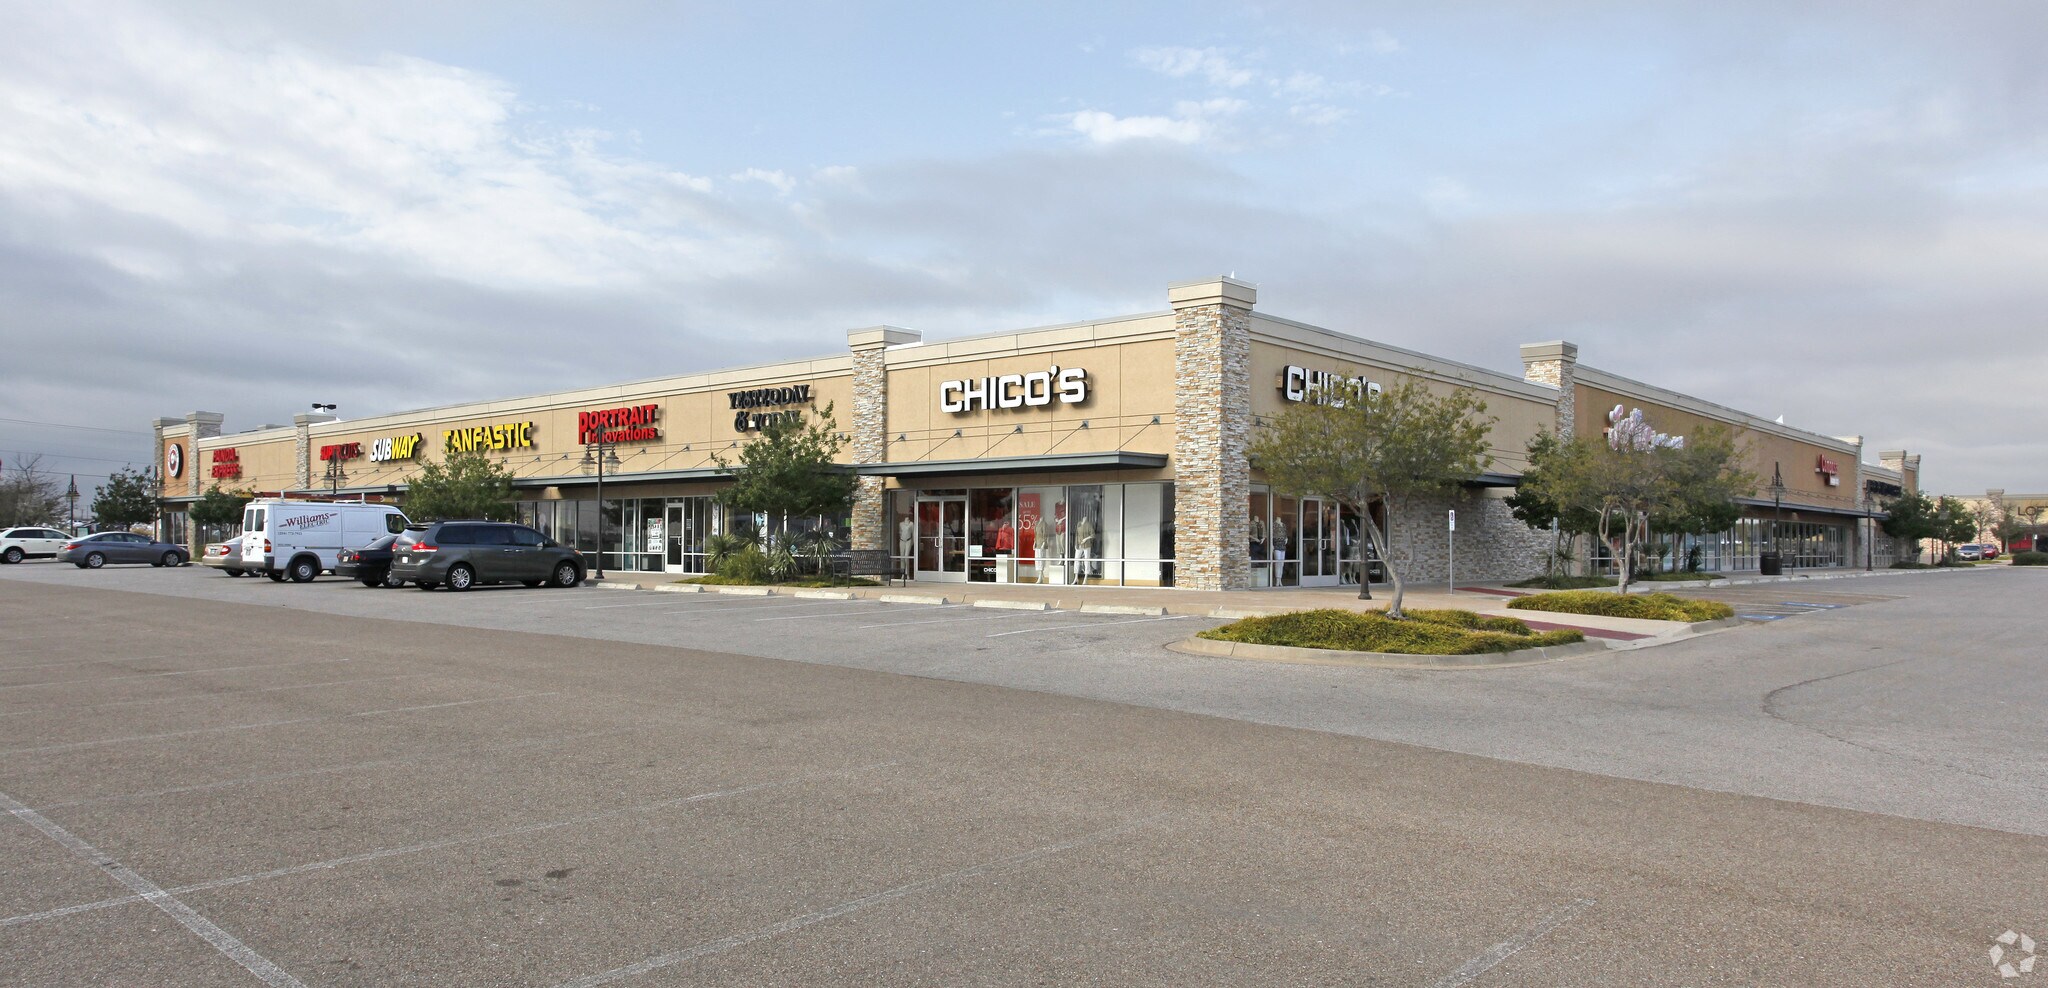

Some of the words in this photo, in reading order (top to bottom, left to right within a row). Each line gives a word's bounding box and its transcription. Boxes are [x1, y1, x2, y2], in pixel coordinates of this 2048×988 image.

[728, 384, 810, 409] YESTERDAY
[940, 365, 1088, 413] CHICO'S
[578, 404, 658, 445] PORTRAIT
[734, 411, 750, 433] &
[370, 432, 422, 462] SUBWAY
[442, 421, 533, 453] TANFASTIC
[213, 447, 237, 462] PANDA
[286, 512, 330, 527] Williams
